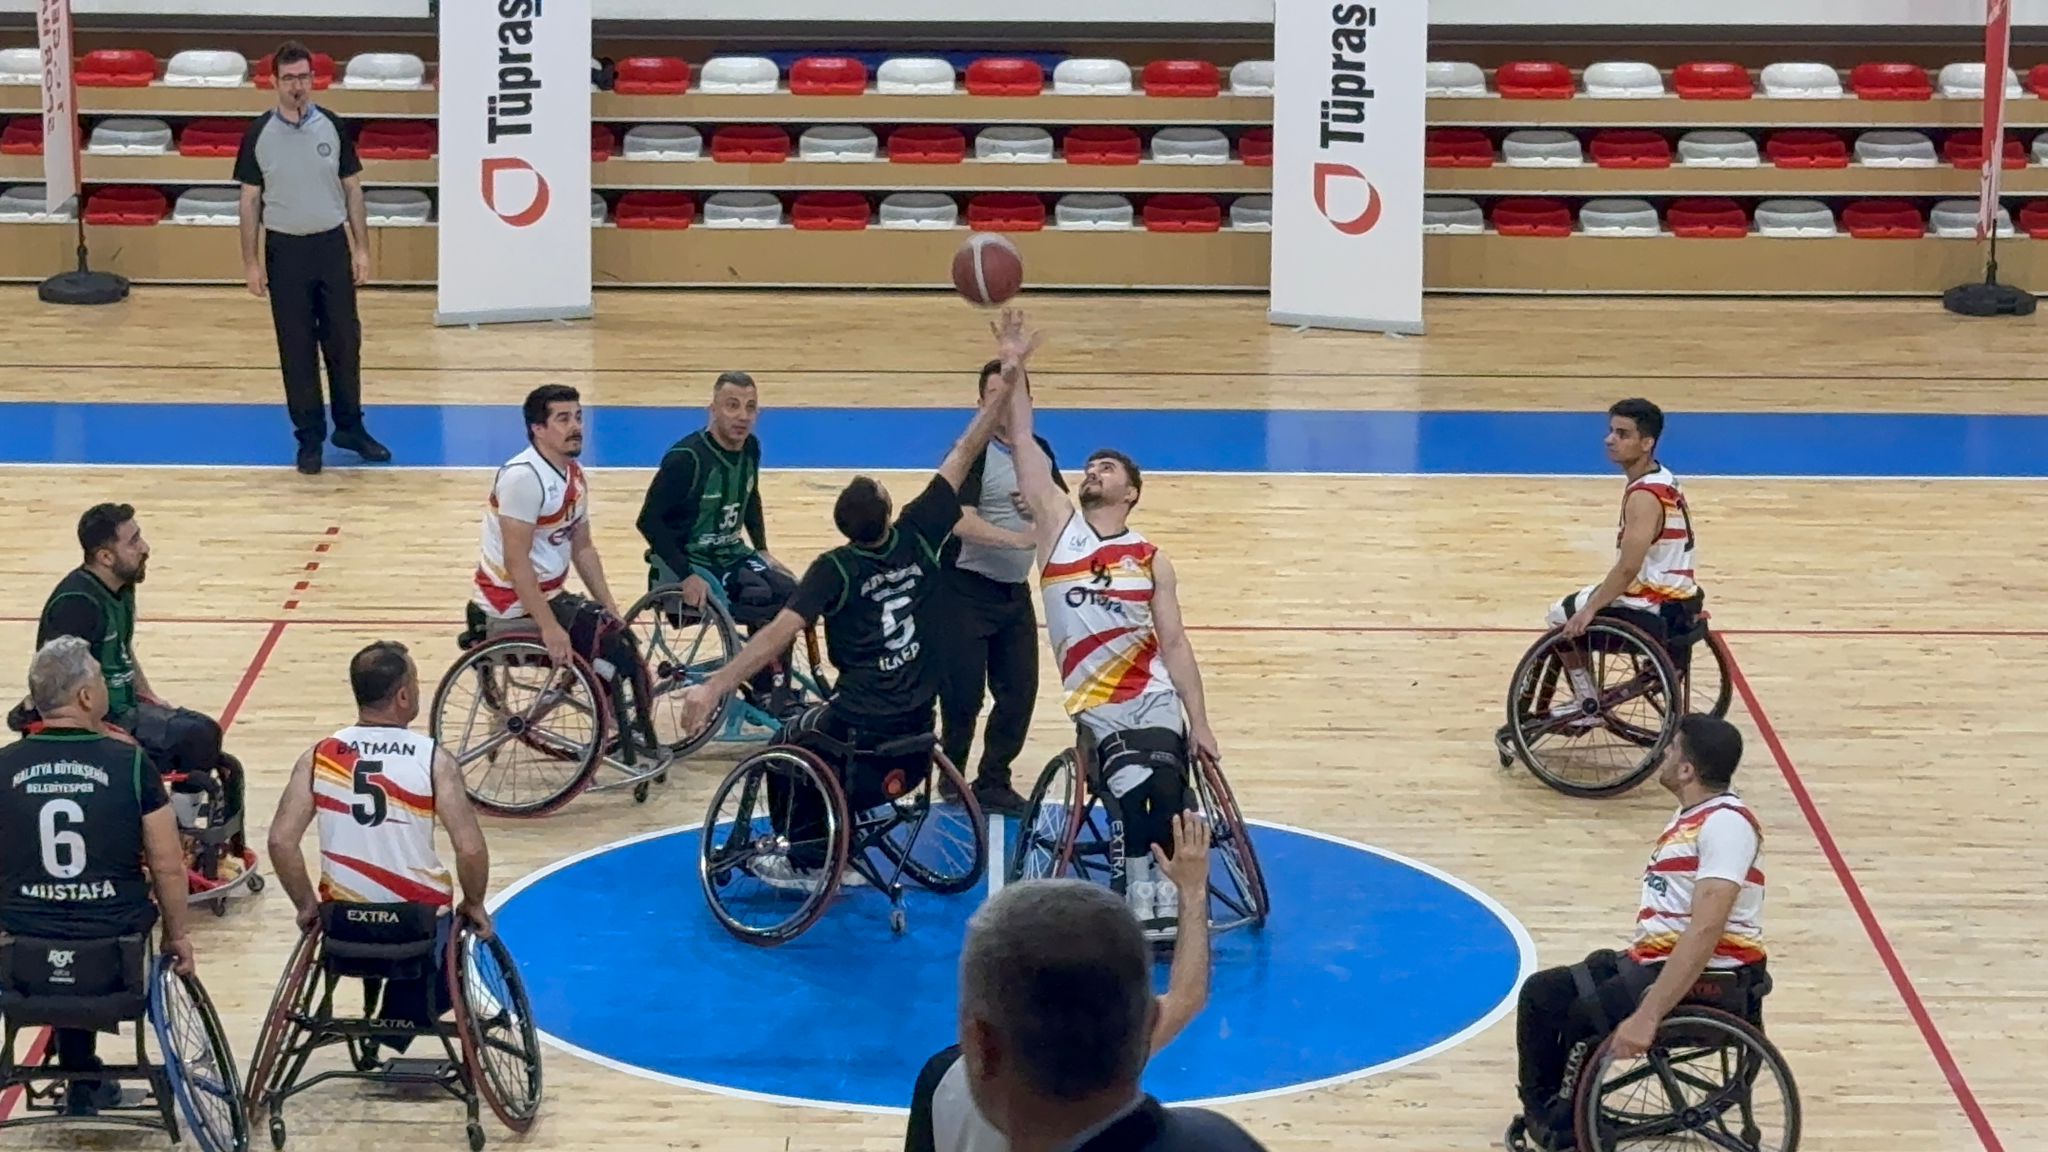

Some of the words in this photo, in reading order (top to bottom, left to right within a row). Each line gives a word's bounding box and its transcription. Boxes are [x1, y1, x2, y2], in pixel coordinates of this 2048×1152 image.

[1320, 4, 1376, 149] Tüpraş
[881, 596, 914, 651] 5
[336, 740, 416, 757] BATMAN
[12, 762, 53, 788] MALATYA
[26, 781, 95, 793] BELEDİYESPOR
[351, 759, 388, 828] 5
[39, 798, 87, 879] 6
[1111, 820, 1125, 879] EXTRA
[21, 880, 117, 901] MUSTAFA
[347, 910, 400, 923] EXTRA
[368, 1018, 415, 1029] EXTRA
